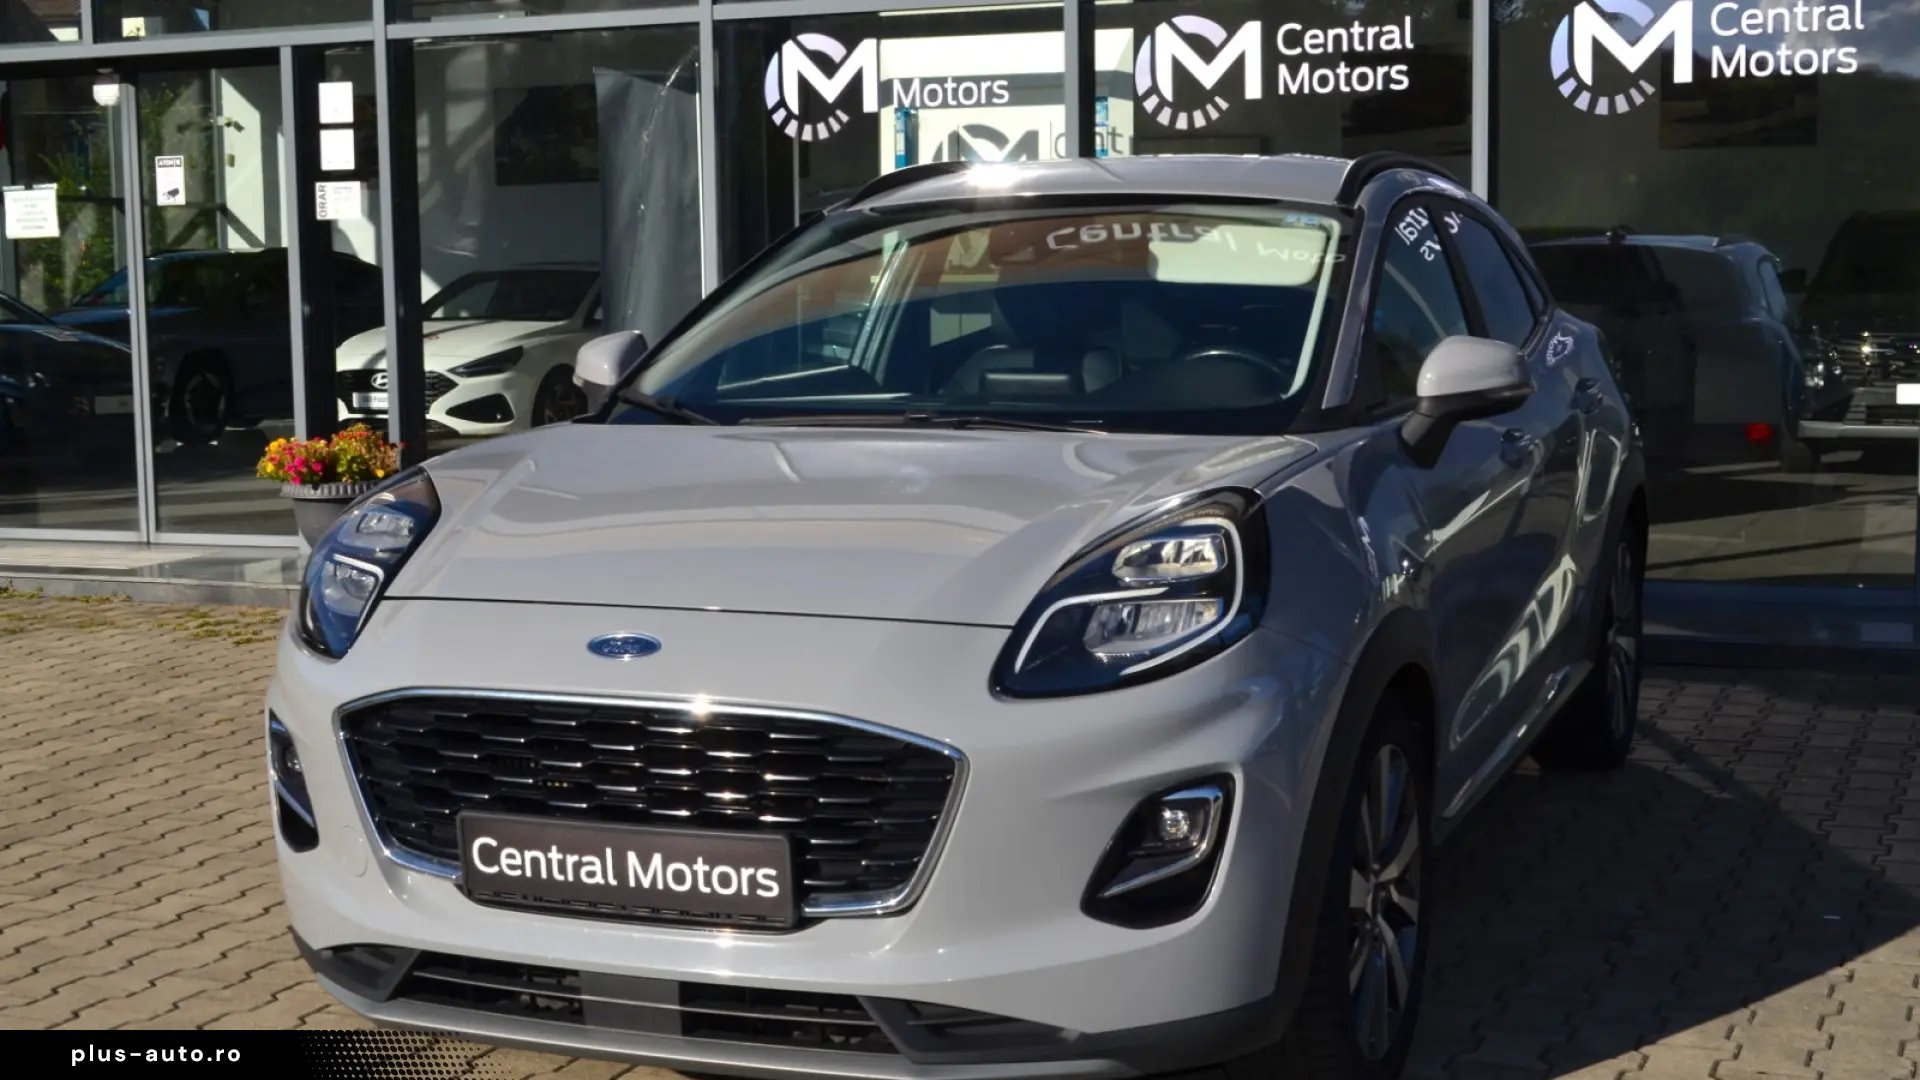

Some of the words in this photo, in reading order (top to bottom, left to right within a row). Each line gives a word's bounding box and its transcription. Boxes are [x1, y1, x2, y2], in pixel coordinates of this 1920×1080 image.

[1276, 16, 1414, 56] Central
[1710, 0, 1865, 36] Central
[1278, 61, 1410, 95] Motors
[1710, 42, 1859, 79] Motors
[892, 76, 1010, 108] Motors
[317, 184, 328, 218] ORAR
[471, 836, 618, 886] Central
[626, 850, 780, 898] Motors
